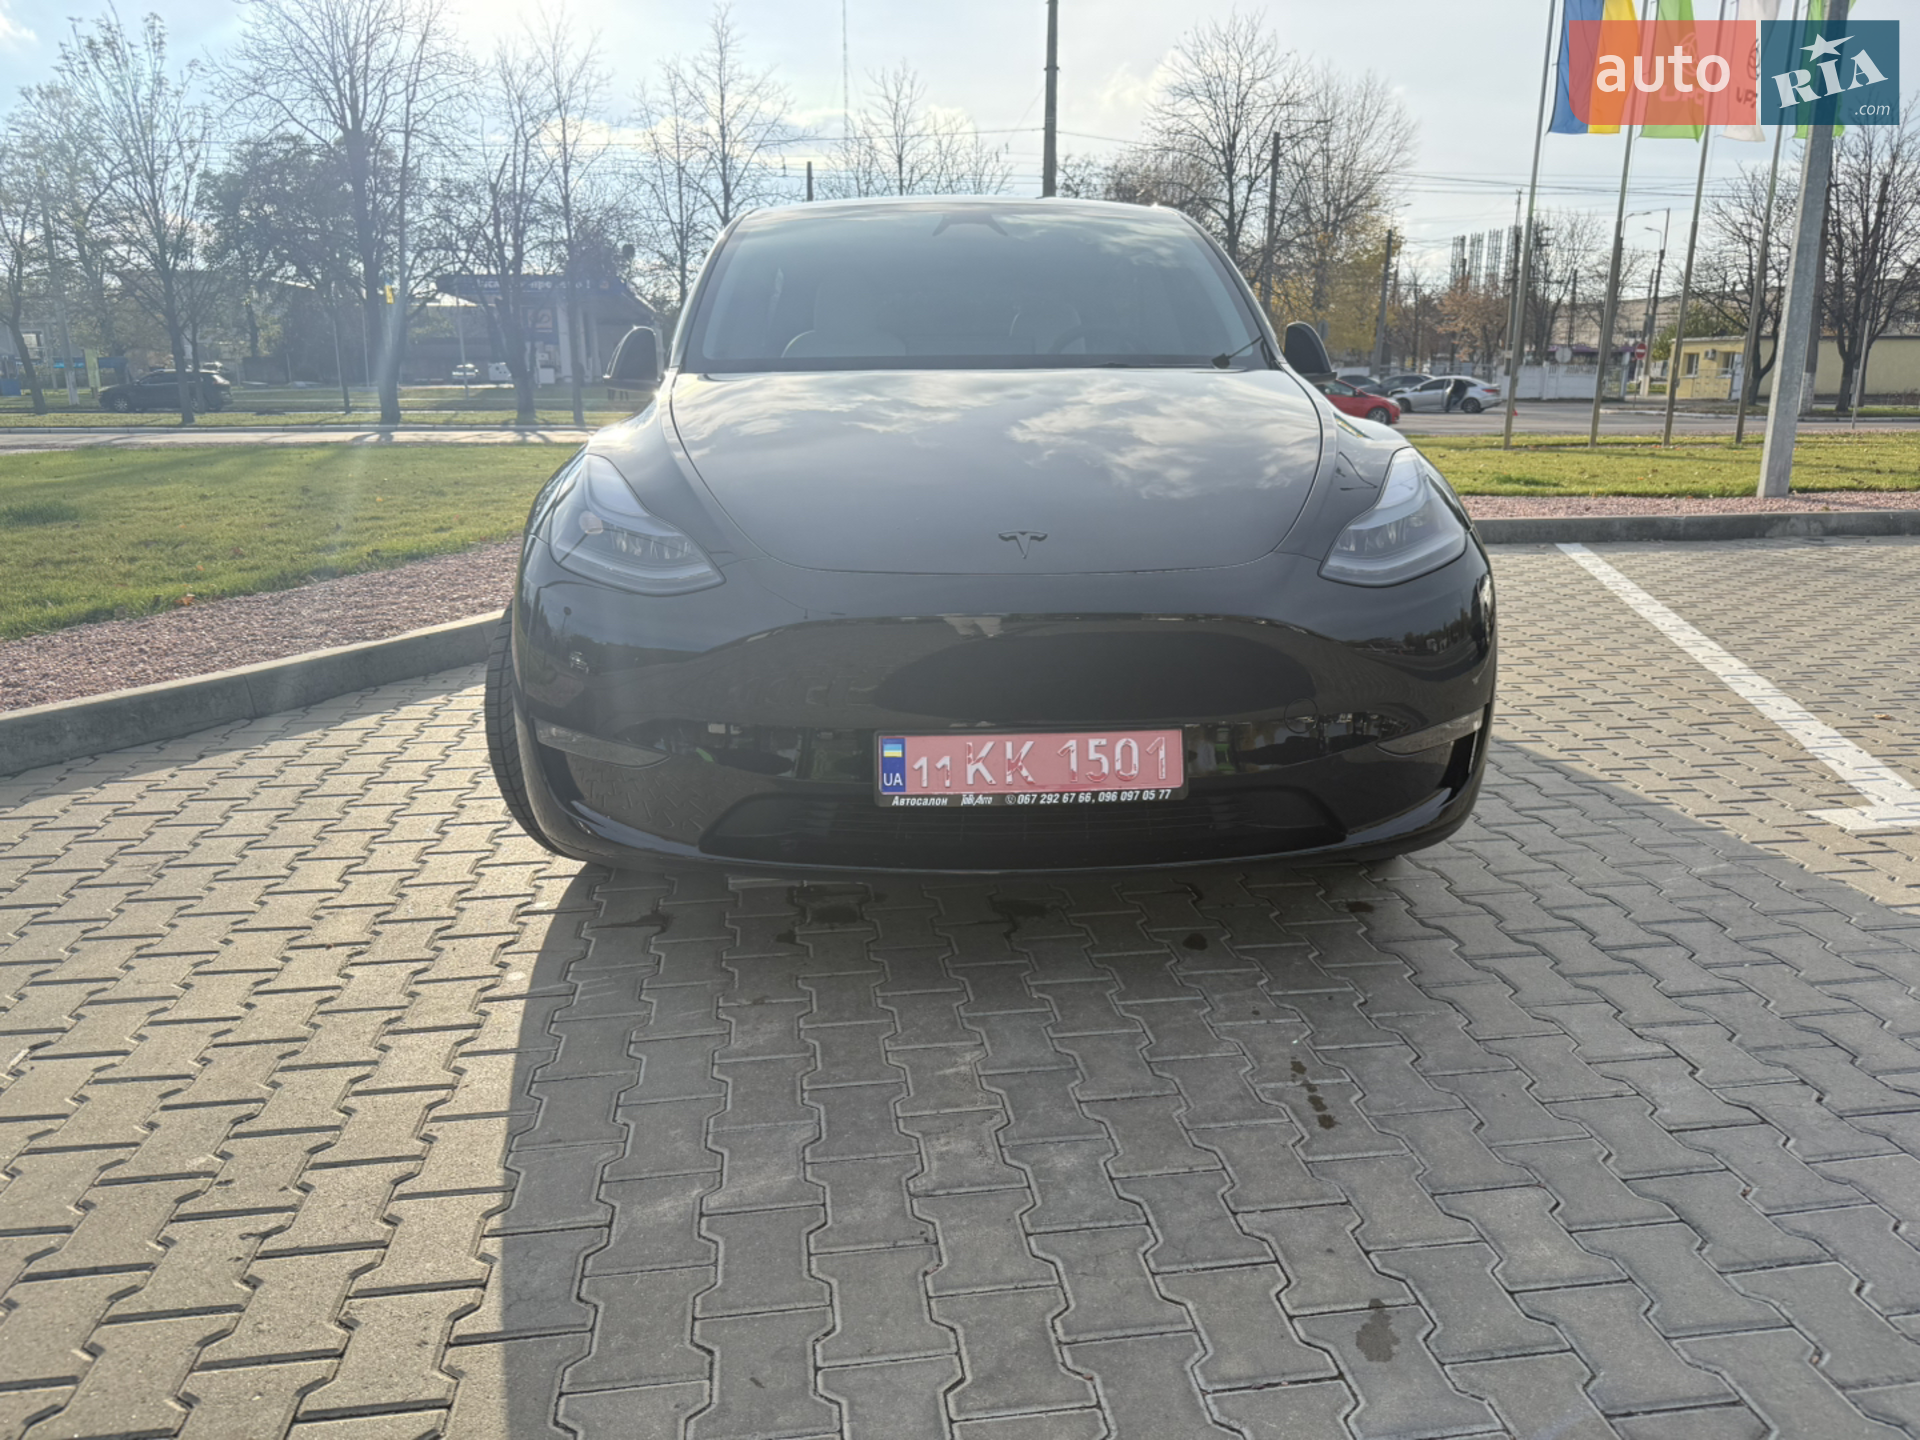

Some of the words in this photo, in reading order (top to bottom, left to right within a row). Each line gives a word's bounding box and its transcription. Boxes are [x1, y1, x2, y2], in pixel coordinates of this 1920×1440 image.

[912, 756, 951, 788] 11
[966, 740, 1036, 785] KK
[1057, 736, 1167, 784] 1501
[883, 772, 904, 786] UA
[891, 795, 948, 807] Автосалон
[1017, 793, 1038, 805] 067
[1039, 793, 1060, 805] 292
[1062, 792, 1075, 804] 67
[1098, 791, 1118, 802] 096
[1120, 790, 1141, 801] 097
[1142, 789, 1156, 800] 05
[1158, 788, 1172, 800] 77
